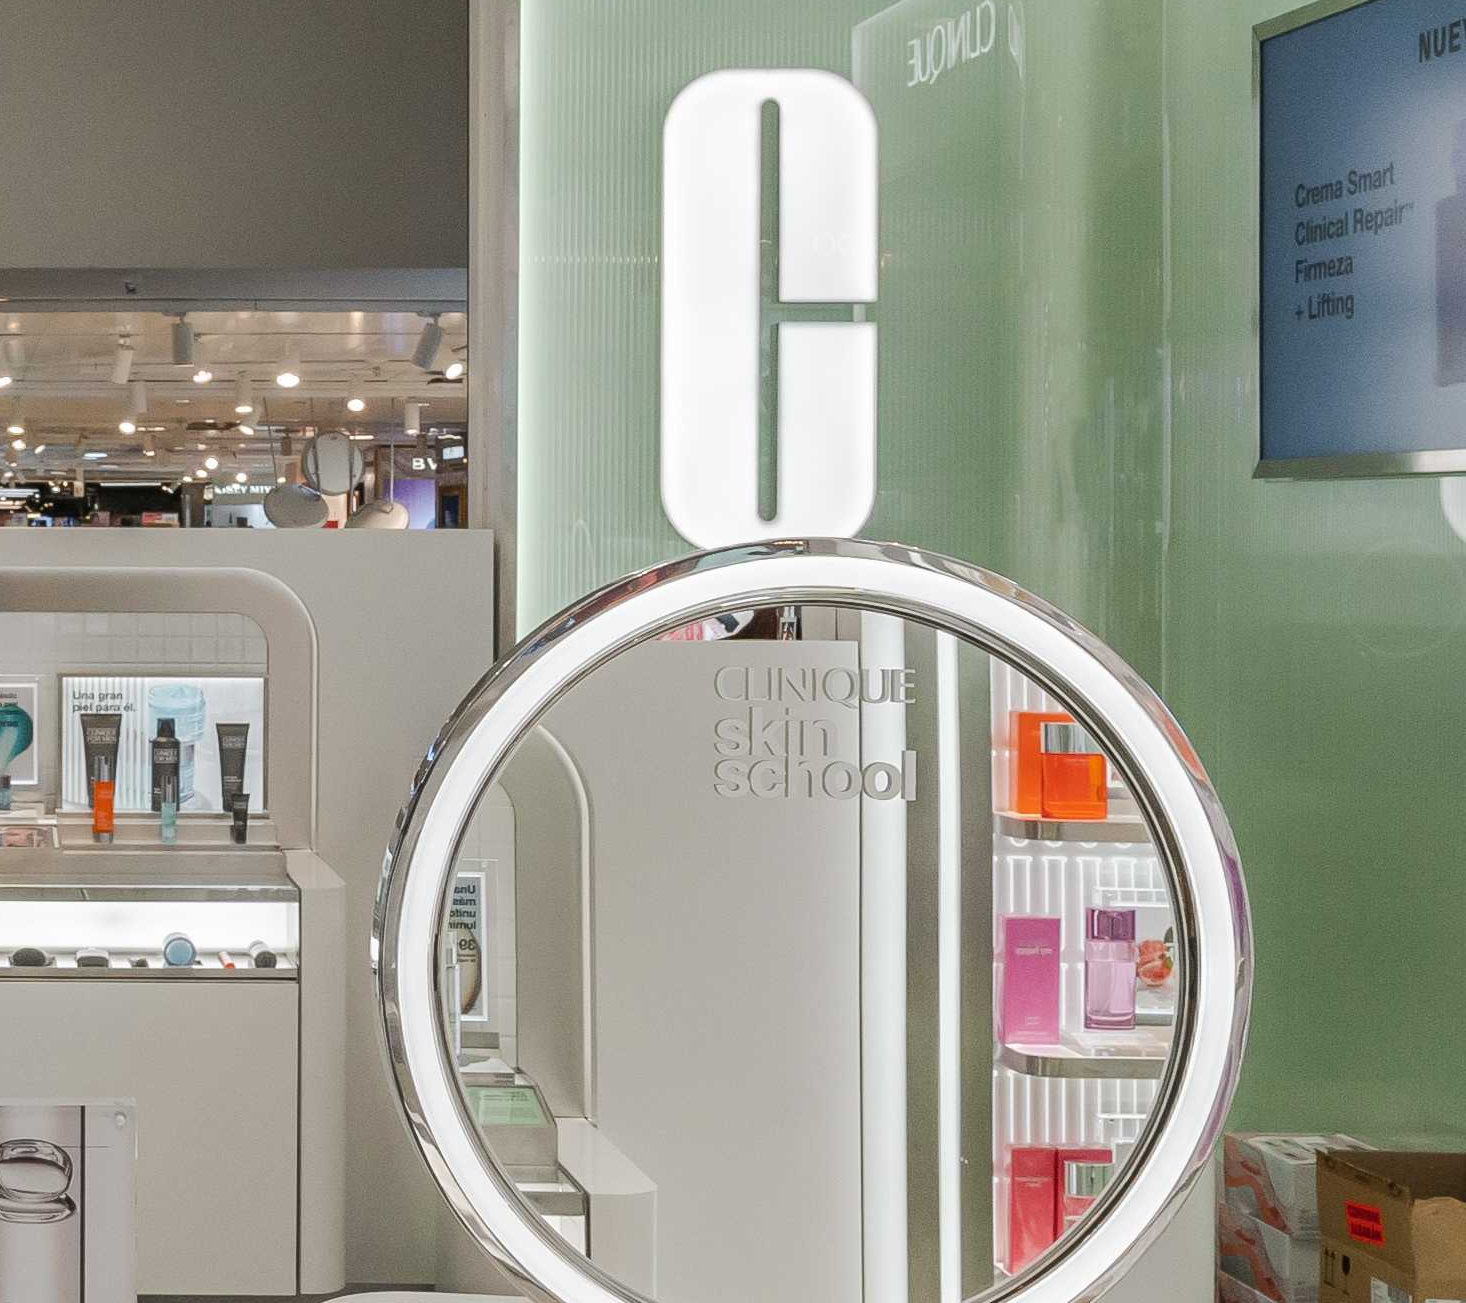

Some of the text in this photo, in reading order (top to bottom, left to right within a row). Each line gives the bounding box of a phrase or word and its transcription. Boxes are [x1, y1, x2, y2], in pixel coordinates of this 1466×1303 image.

[1295, 162, 1396, 209] Crema Smart
[1295, 211, 1349, 247] Clinical
[1294, 253, 1354, 285] Firmeza
[1307, 290, 1355, 322] Lifting
[72, 691, 123, 703] Una gran
[712, 666, 918, 709] CLINIQUE
[72, 703, 137, 712] piel para él.
[713, 708, 838, 758] skin
[712, 752, 918, 801] school
